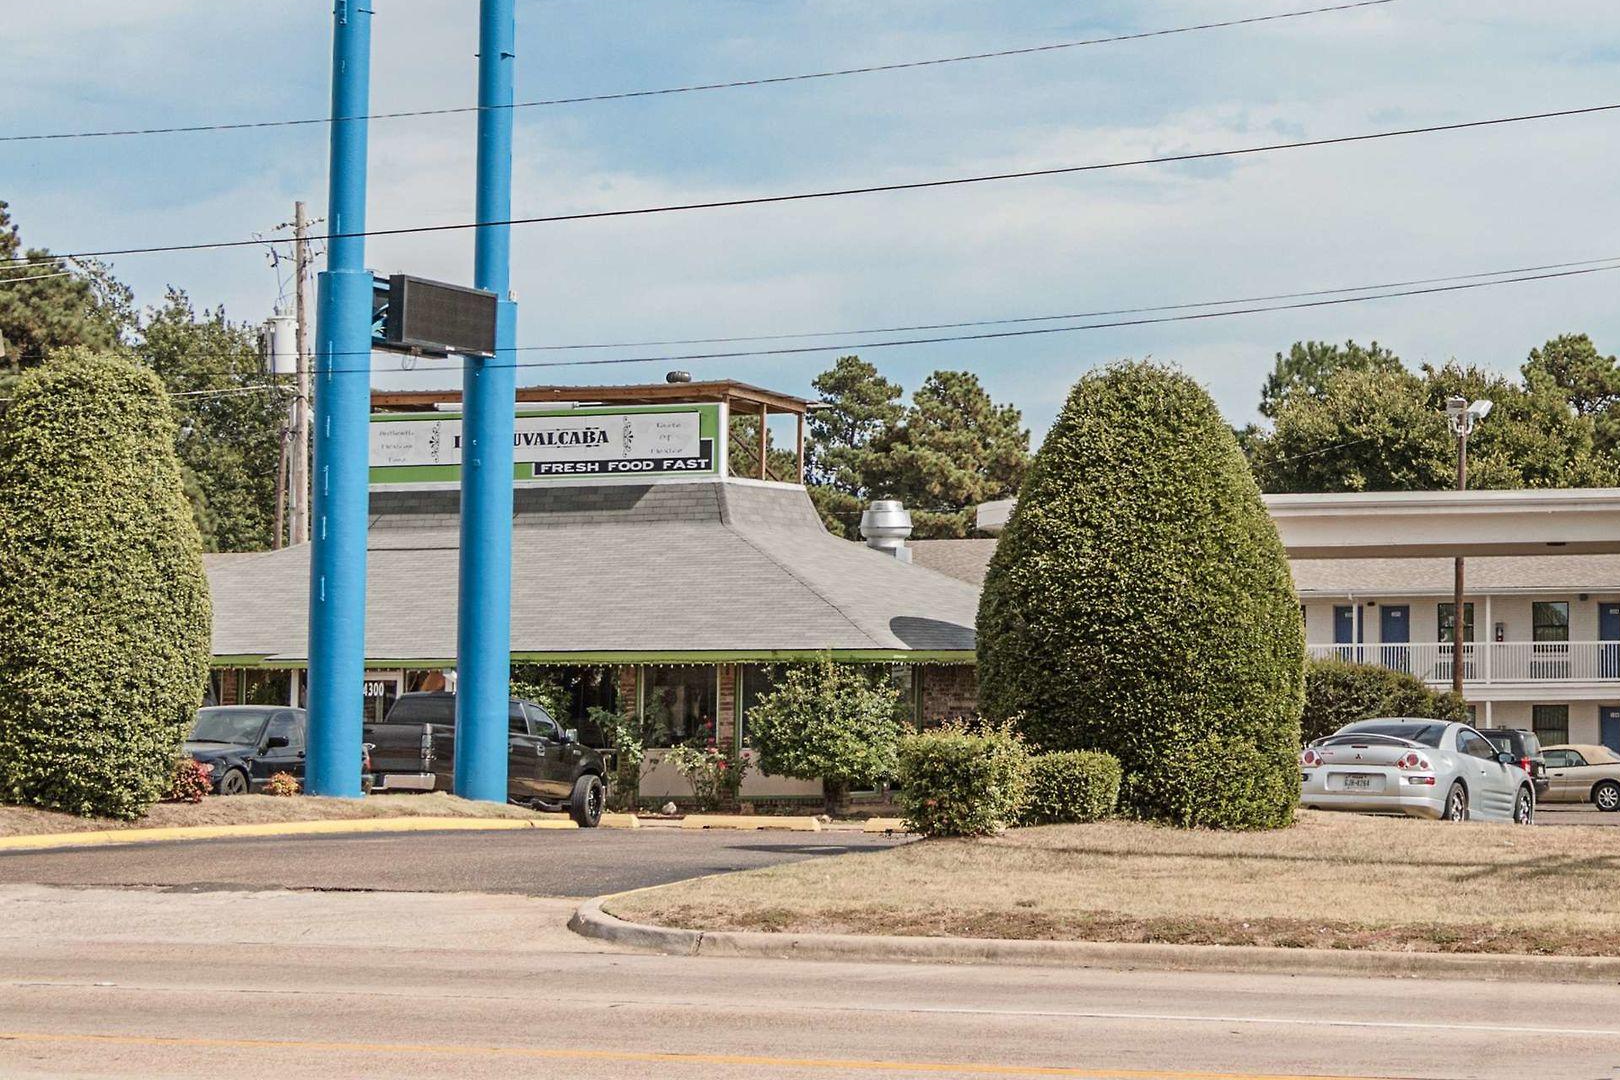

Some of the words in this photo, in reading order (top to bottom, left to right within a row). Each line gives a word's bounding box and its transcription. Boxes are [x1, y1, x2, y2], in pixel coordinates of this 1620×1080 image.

[513, 430, 610, 447] UVALCABA
[540, 462, 600, 473] FRESH
[607, 460, 655, 472] FOOD
[662, 458, 709, 470] FAST
[363, 682, 384, 696] 4300
